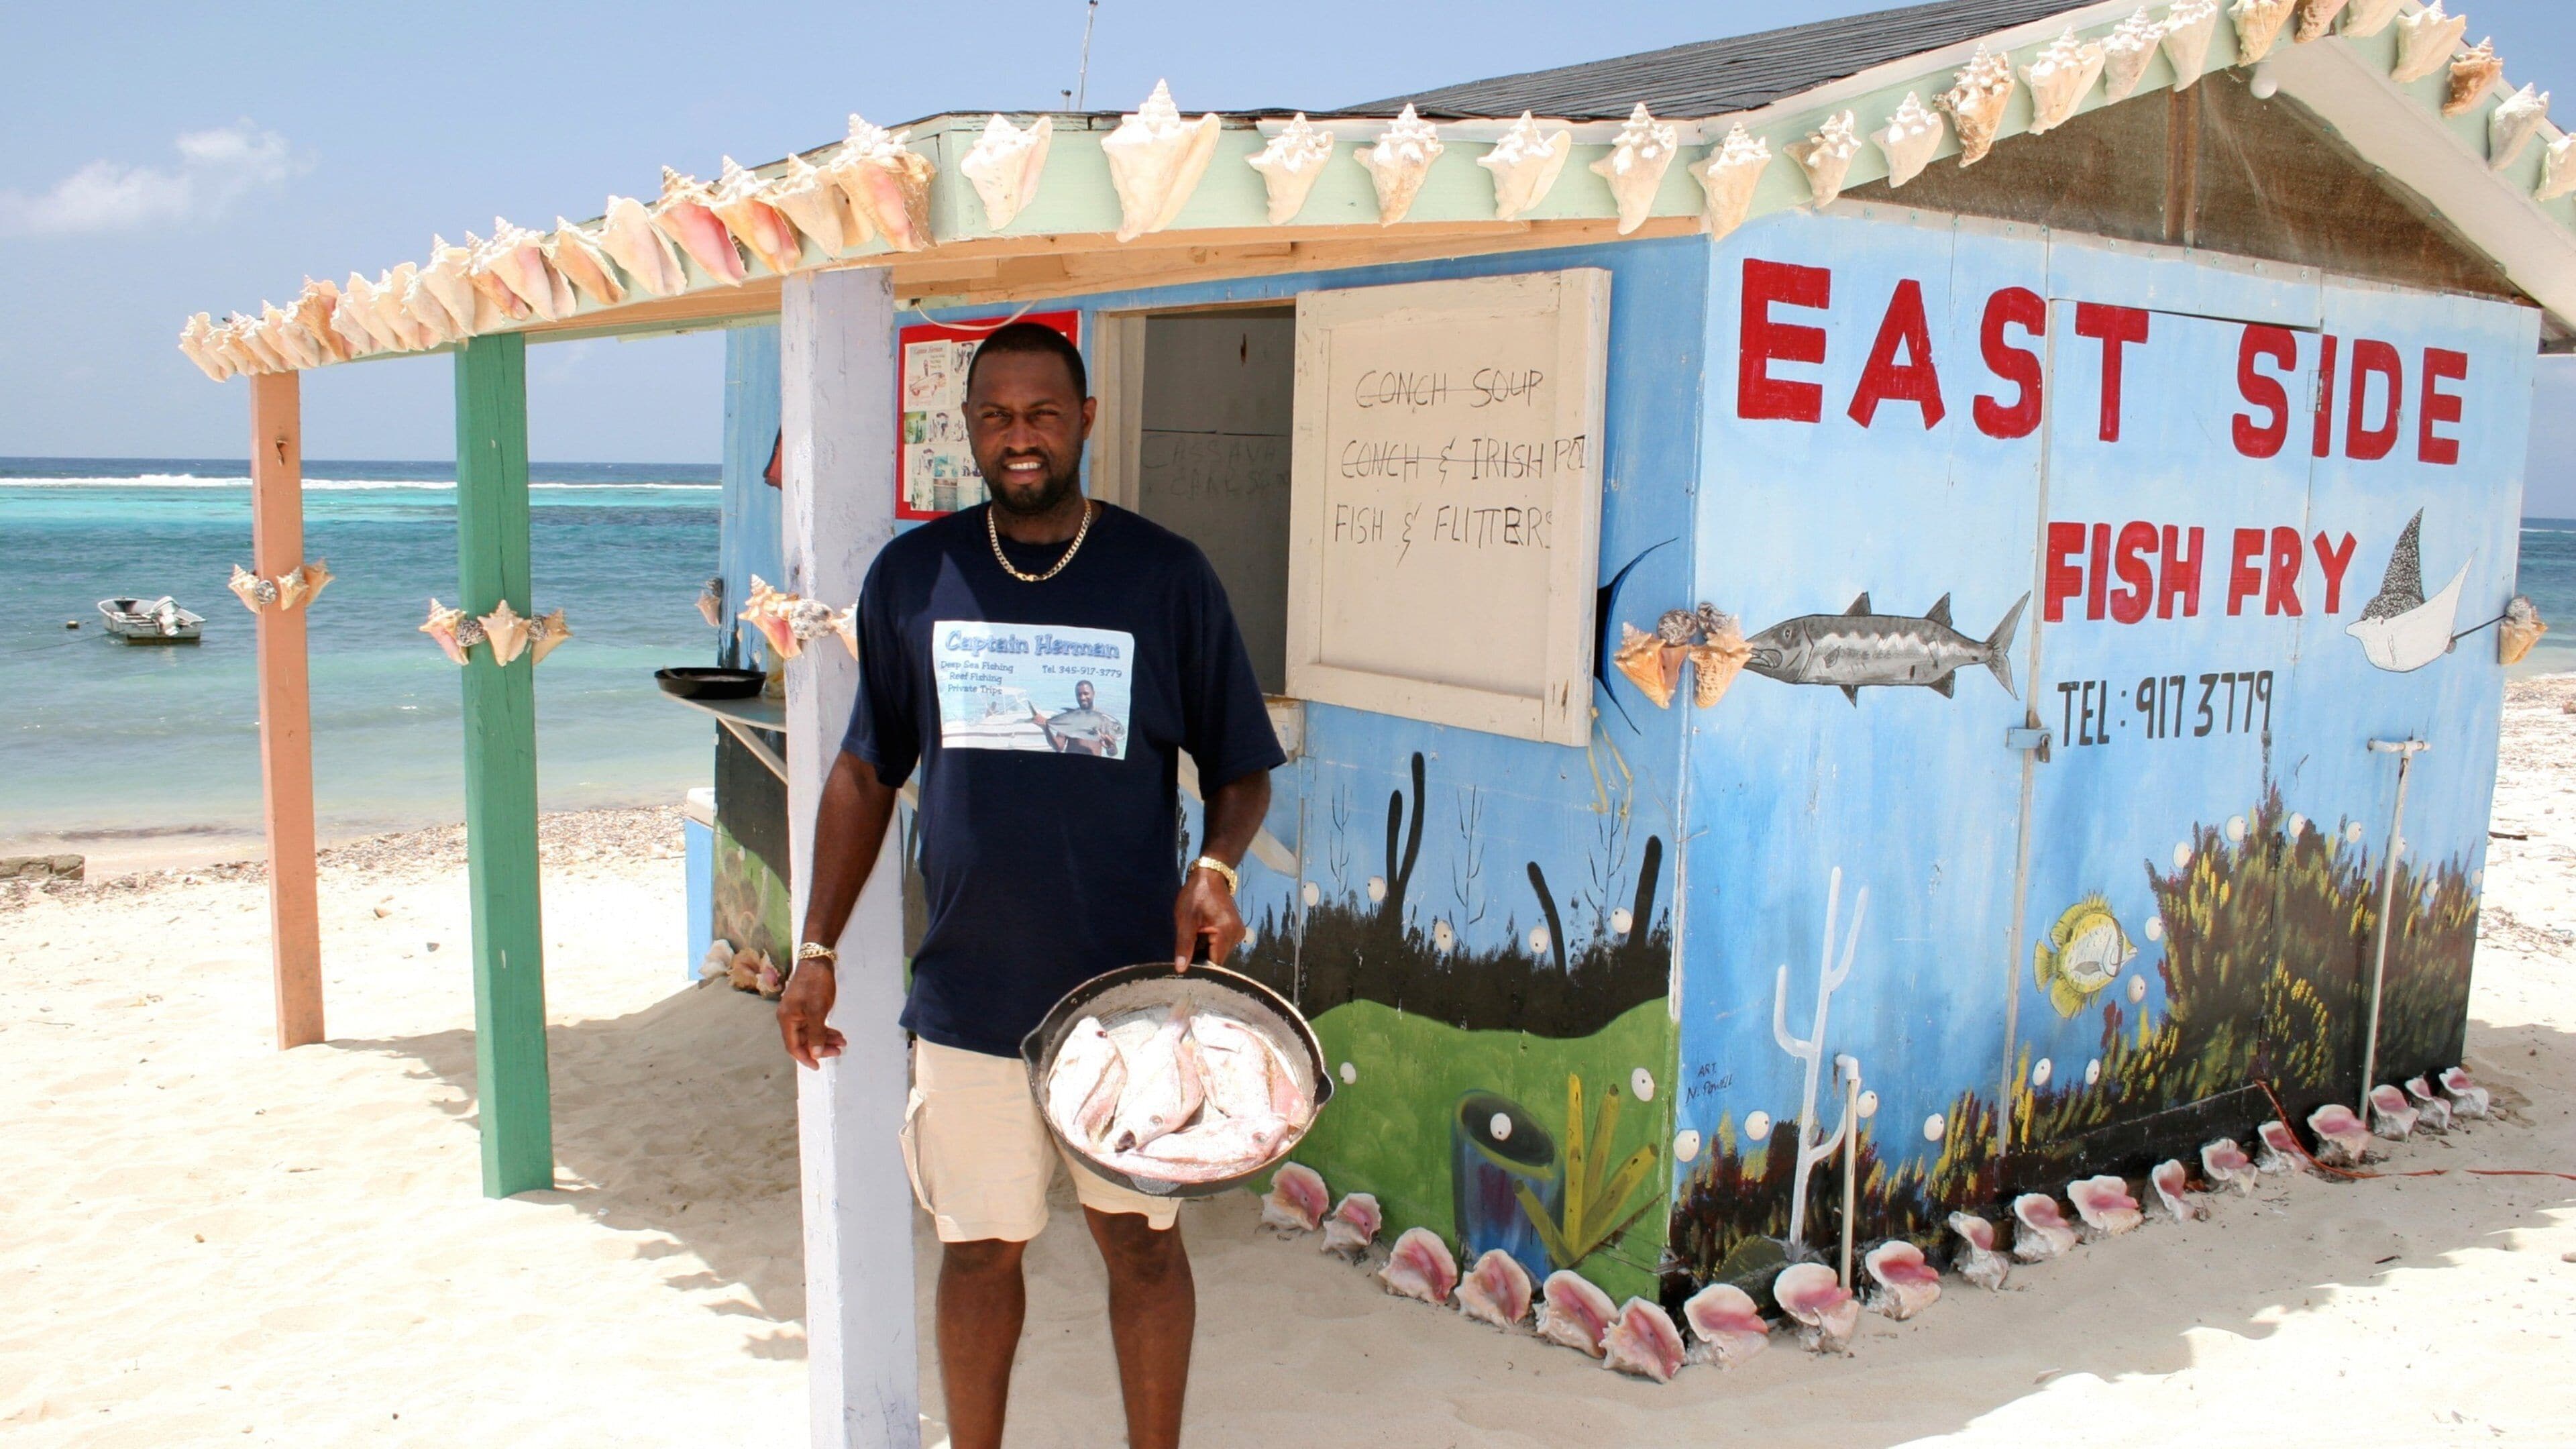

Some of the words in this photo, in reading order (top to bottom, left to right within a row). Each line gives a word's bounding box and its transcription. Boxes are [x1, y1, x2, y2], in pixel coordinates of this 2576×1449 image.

[1737, 258, 2148, 442] EAST
[2232, 325, 2467, 465] SIDE
[1355, 370, 1447, 408] CONCH
[1470, 368, 1544, 407] SOUP
[1342, 439, 1420, 480] CONCH
[1439, 437, 1456, 487] &
[1472, 437, 1544, 480] IRISH
[1335, 504, 1383, 543] FISH
[1397, 503, 1421, 568] &
[2043, 520, 2205, 625] FISH
[2226, 525, 2358, 617] FRY
[945, 631, 1030, 657] Captain
[1034, 634, 1120, 659] Herman
[941, 661, 960, 669] Deep
[964, 661, 979, 669] Sea
[982, 662, 1014, 674] Fishing
[949, 672, 968, 681] Reef
[970, 673, 1002, 685] Fishing
[1059, 665, 1122, 678] 345-917-3779
[948, 684, 977, 694] Private
[980, 685, 1003, 696] Trips
[2135, 674, 2187, 739] 917
[2193, 670, 2274, 737] 3779
